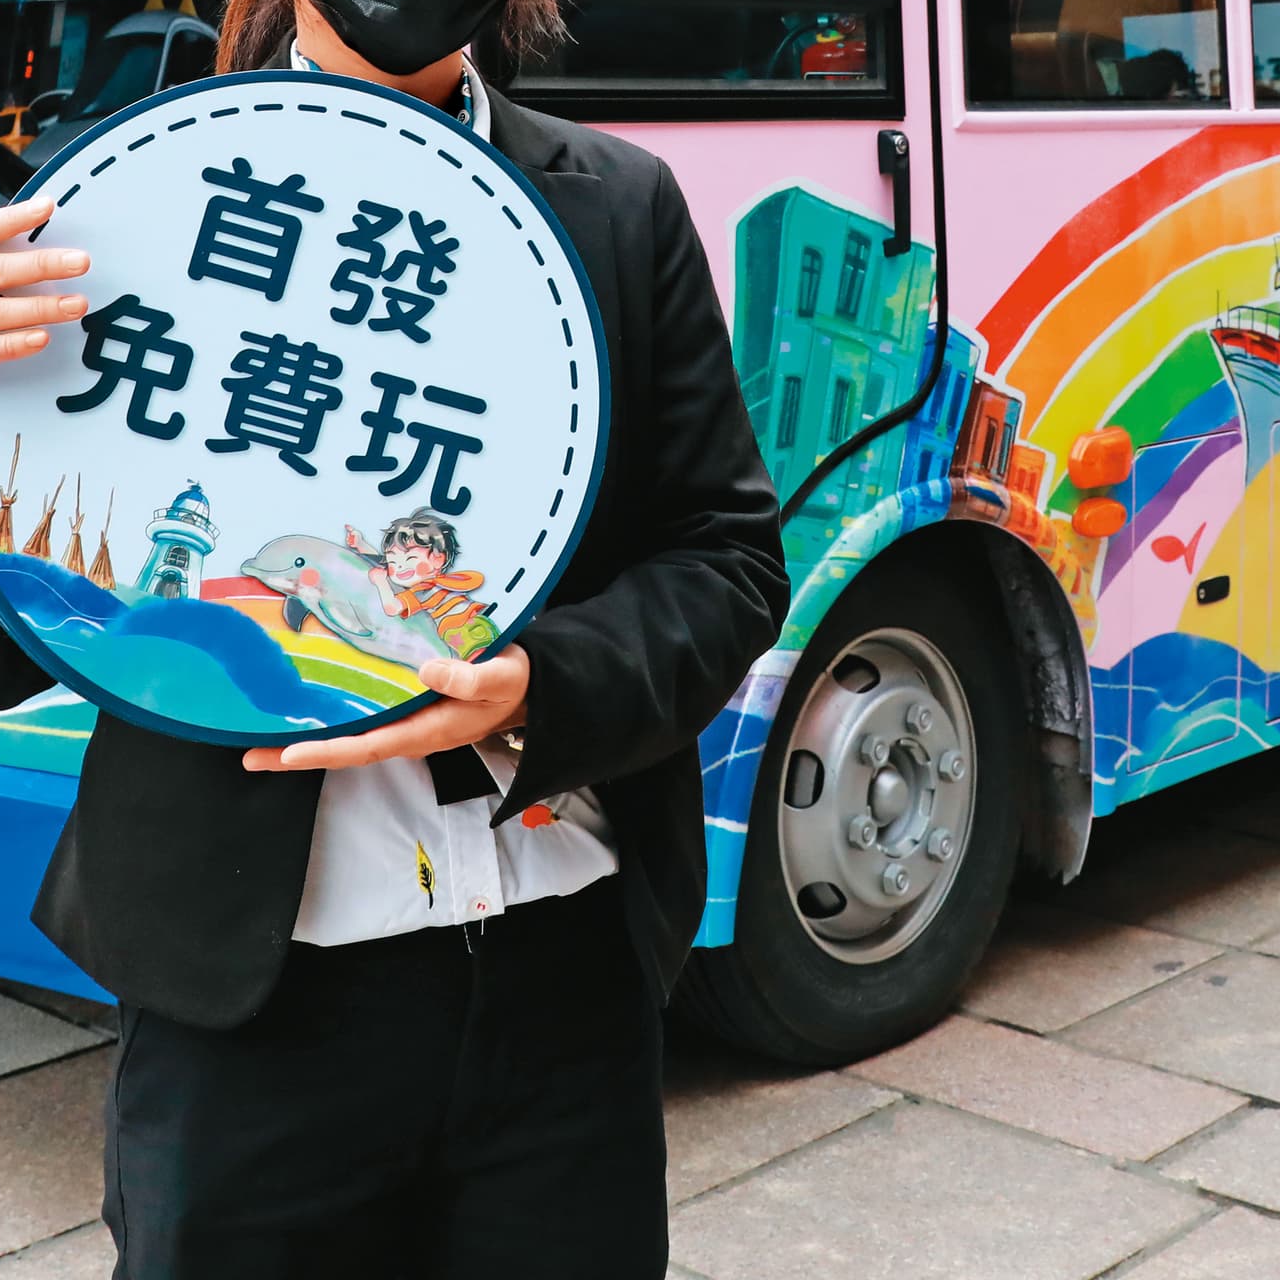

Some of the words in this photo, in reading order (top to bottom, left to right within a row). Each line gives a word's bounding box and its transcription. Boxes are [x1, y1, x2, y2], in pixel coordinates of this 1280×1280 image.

[187, 157, 460, 344] 首發
[55, 293, 488, 517] 免費玩
